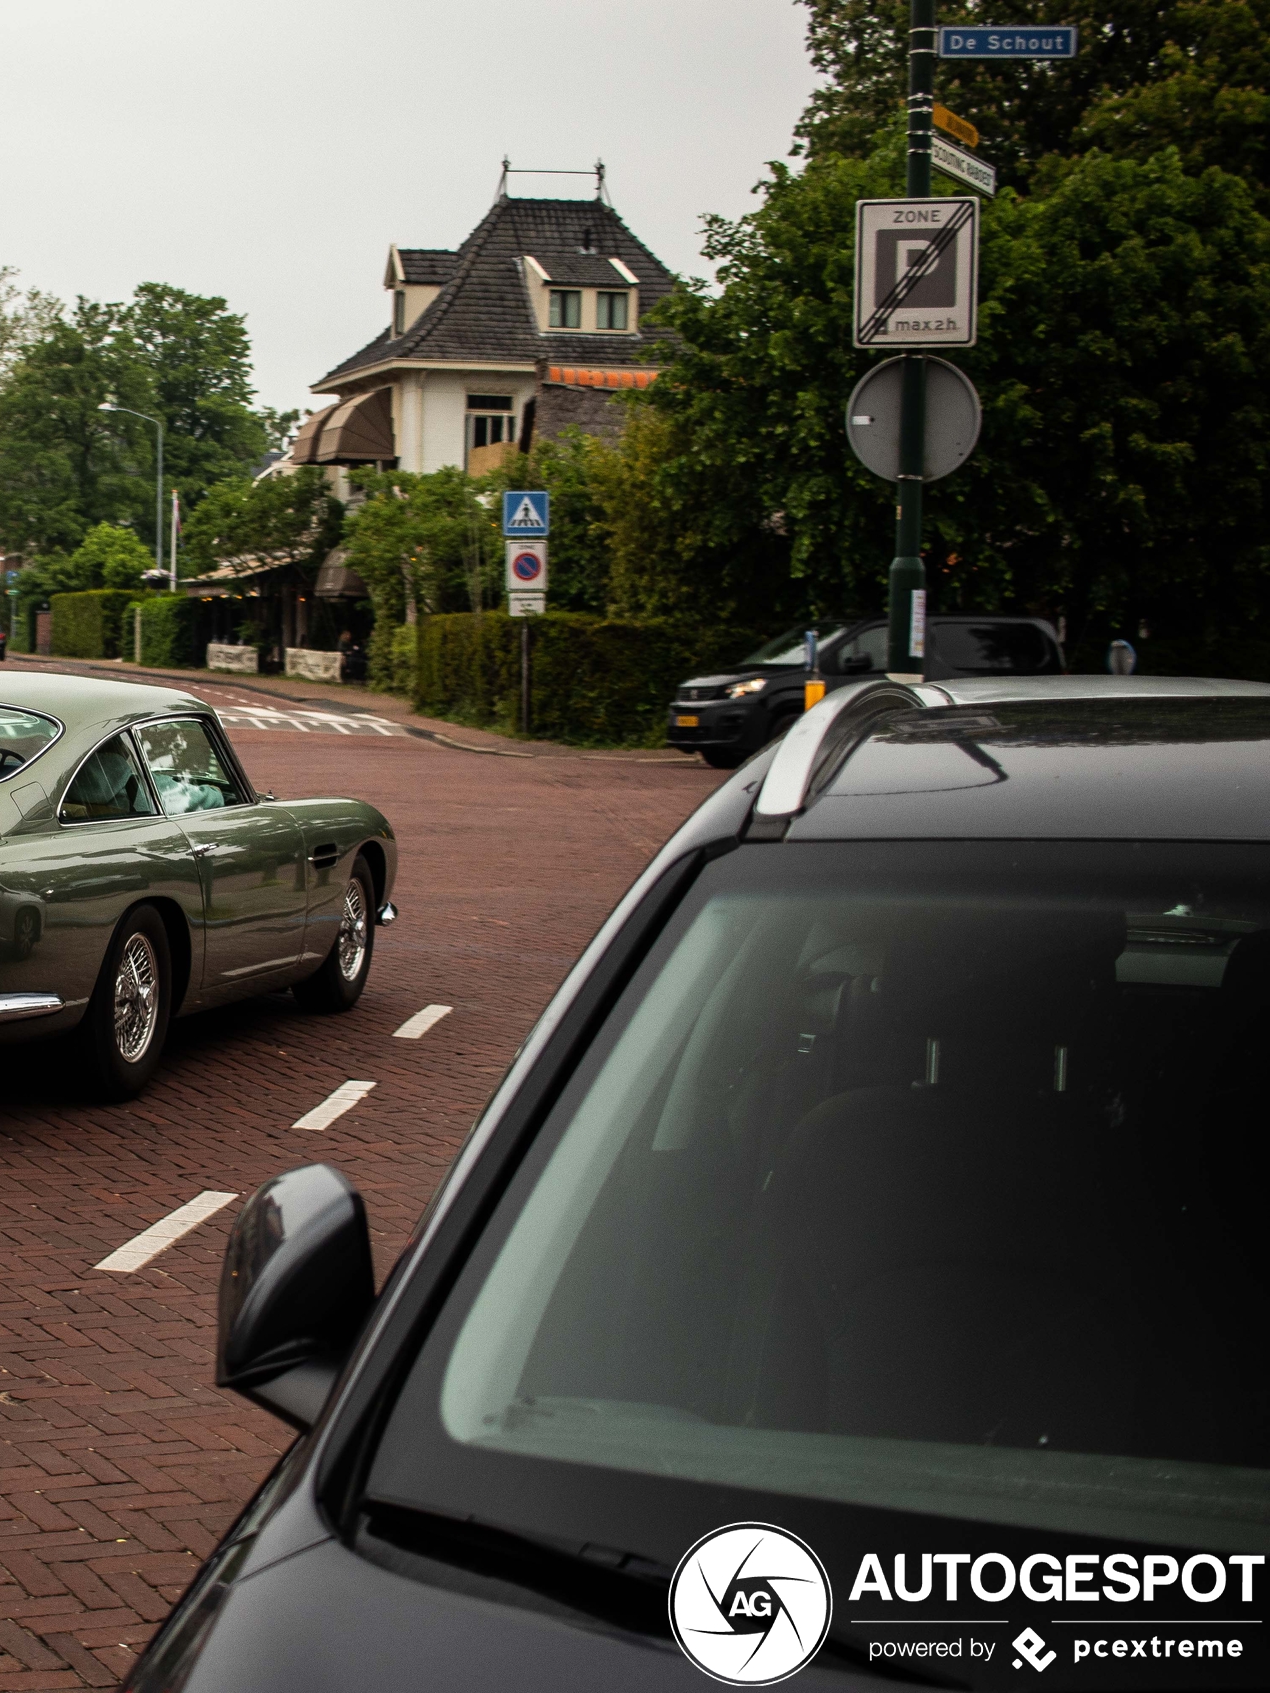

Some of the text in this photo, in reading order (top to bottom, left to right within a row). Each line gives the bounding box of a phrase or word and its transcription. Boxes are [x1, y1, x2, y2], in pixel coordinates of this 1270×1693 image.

[950, 35, 1065, 50] De Schout
[893, 209, 941, 223] ZONE
